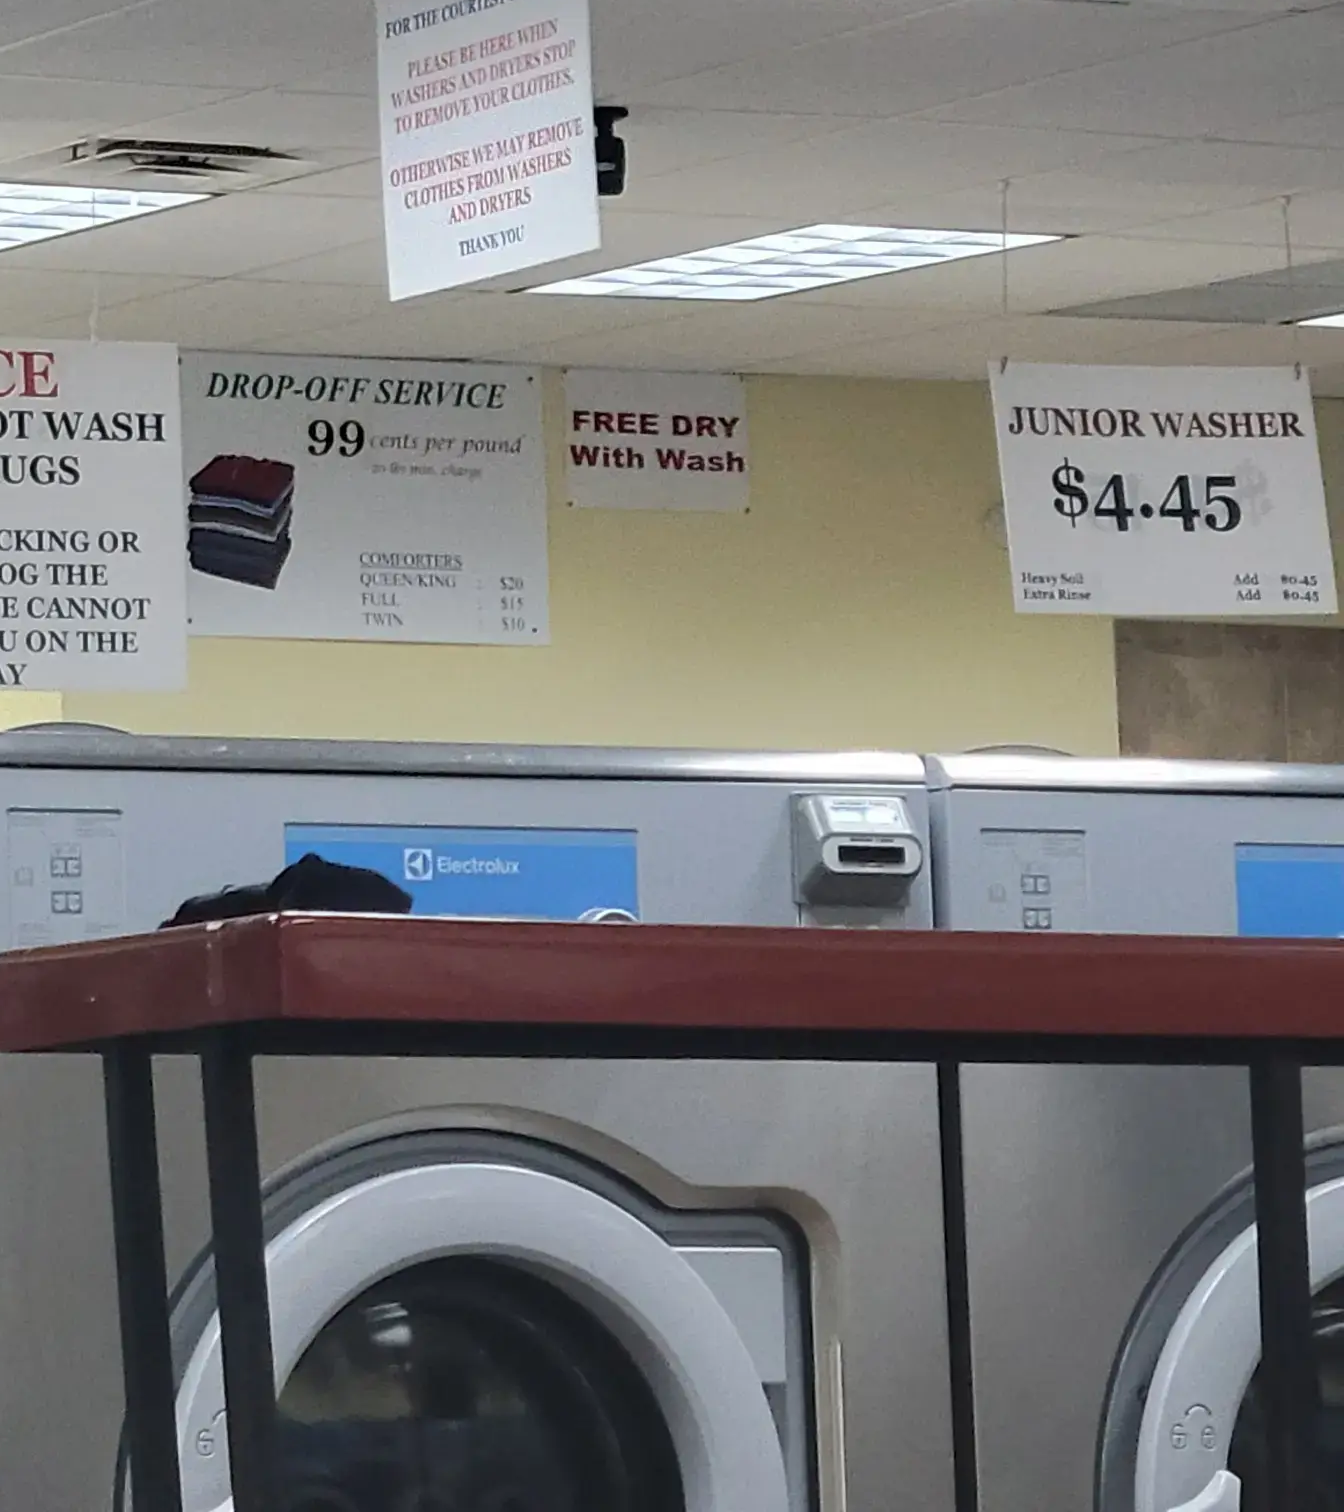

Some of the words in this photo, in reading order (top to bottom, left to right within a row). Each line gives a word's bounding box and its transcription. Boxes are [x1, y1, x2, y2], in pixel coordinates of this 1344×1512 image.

[386, 17, 410, 38] FOR
[413, 9, 439, 30] THE
[408, 50, 458, 78] PLEASE
[460, 44, 477, 64] BE
[480, 32, 514, 58] HERE
[517, 18, 558, 45] WHEN
[391, 76, 456, 108] WASHERS
[462, 67, 487, 89] AND
[490, 52, 541, 81] DRYERS
[543, 39, 576, 65] STOP
[395, 114, 412, 134] TO
[414, 98, 471, 130] REMOVE
[473, 87, 511, 112] YOUR
[390, 150, 470, 187] OTHERWISE
[472, 143, 494, 164] WE
[496, 135, 525, 159] MAY
[528, 117, 584, 150] REMOVE
[404, 178, 465, 210] CLOTHES
[468, 167, 504, 194] FROM
[507, 147, 572, 182] WASHERS
[450, 202, 476, 225] AND
[480, 187, 532, 217] DRYERS
[459, 232, 499, 256] THANK
[501, 225, 524, 247] YOU
[206, 372, 370, 402] DROP-OFF
[374, 378, 508, 409] SERVICE
[42, 411, 166, 443] WASH
[572, 410, 659, 435] FREE
[671, 414, 740, 438] DRY
[1009, 406, 1145, 437] JUNIOR
[1150, 411, 1304, 438] WASHER
[307, 419, 365, 457] 99
[369, 433, 418, 450] cents
[422, 436, 455, 457] per
[460, 434, 525, 457] pound
[570, 444, 645, 469] With
[656, 448, 745, 473] Wash
[1052, 456, 1243, 532] $4.45
[97, 531, 142, 554] OR
[46, 563, 108, 587] THE
[359, 552, 463, 569] COMFORTERS
[1021, 571, 1058, 587] Heavy
[1060, 572, 1084, 585] Soil
[1233, 572, 1259, 586] Add
[26, 596, 151, 621] CANNOT
[361, 591, 400, 607] FULL
[1023, 588, 1056, 600] Extra
[1058, 588, 1092, 601] Rinse
[1236, 588, 1261, 601] Add
[362, 611, 404, 627] TWIN
[25, 630, 68, 653] ON
[76, 631, 139, 654] THE
[436, 856, 520, 875] Electrolux
